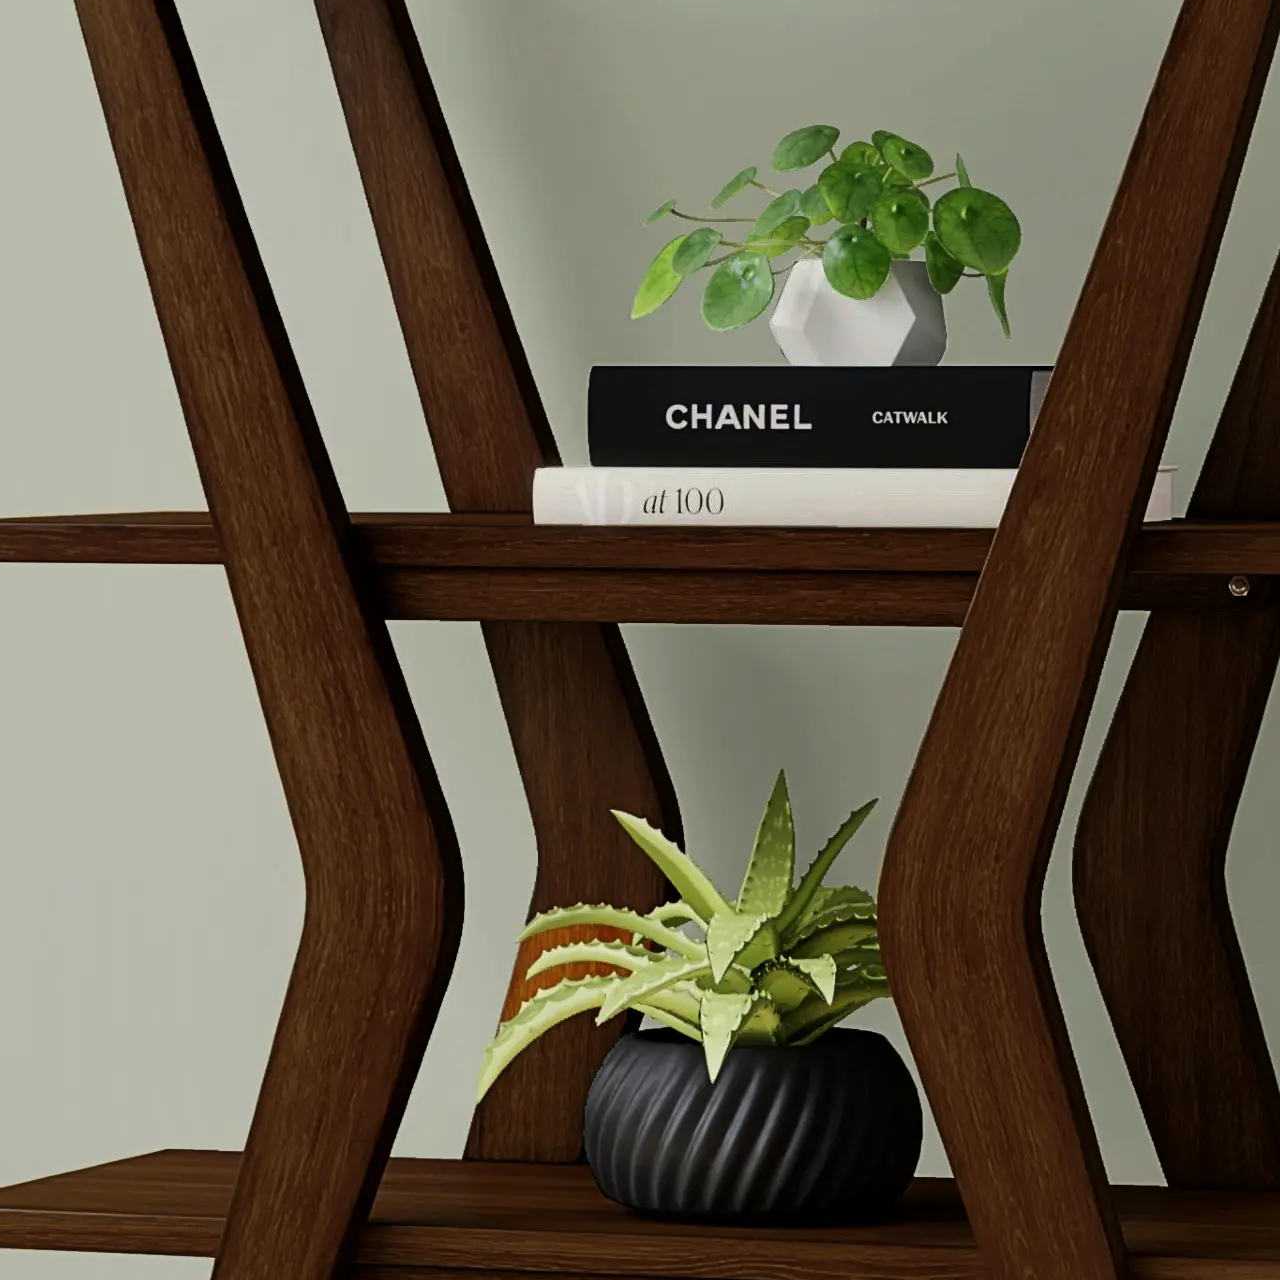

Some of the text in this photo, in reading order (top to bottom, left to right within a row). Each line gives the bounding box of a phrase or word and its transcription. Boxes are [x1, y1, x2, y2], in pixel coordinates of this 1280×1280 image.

[665, 403, 949, 431] CHANEL CATWALK
[642, 488, 669, 515] at
[675, 486, 725, 516] 100
